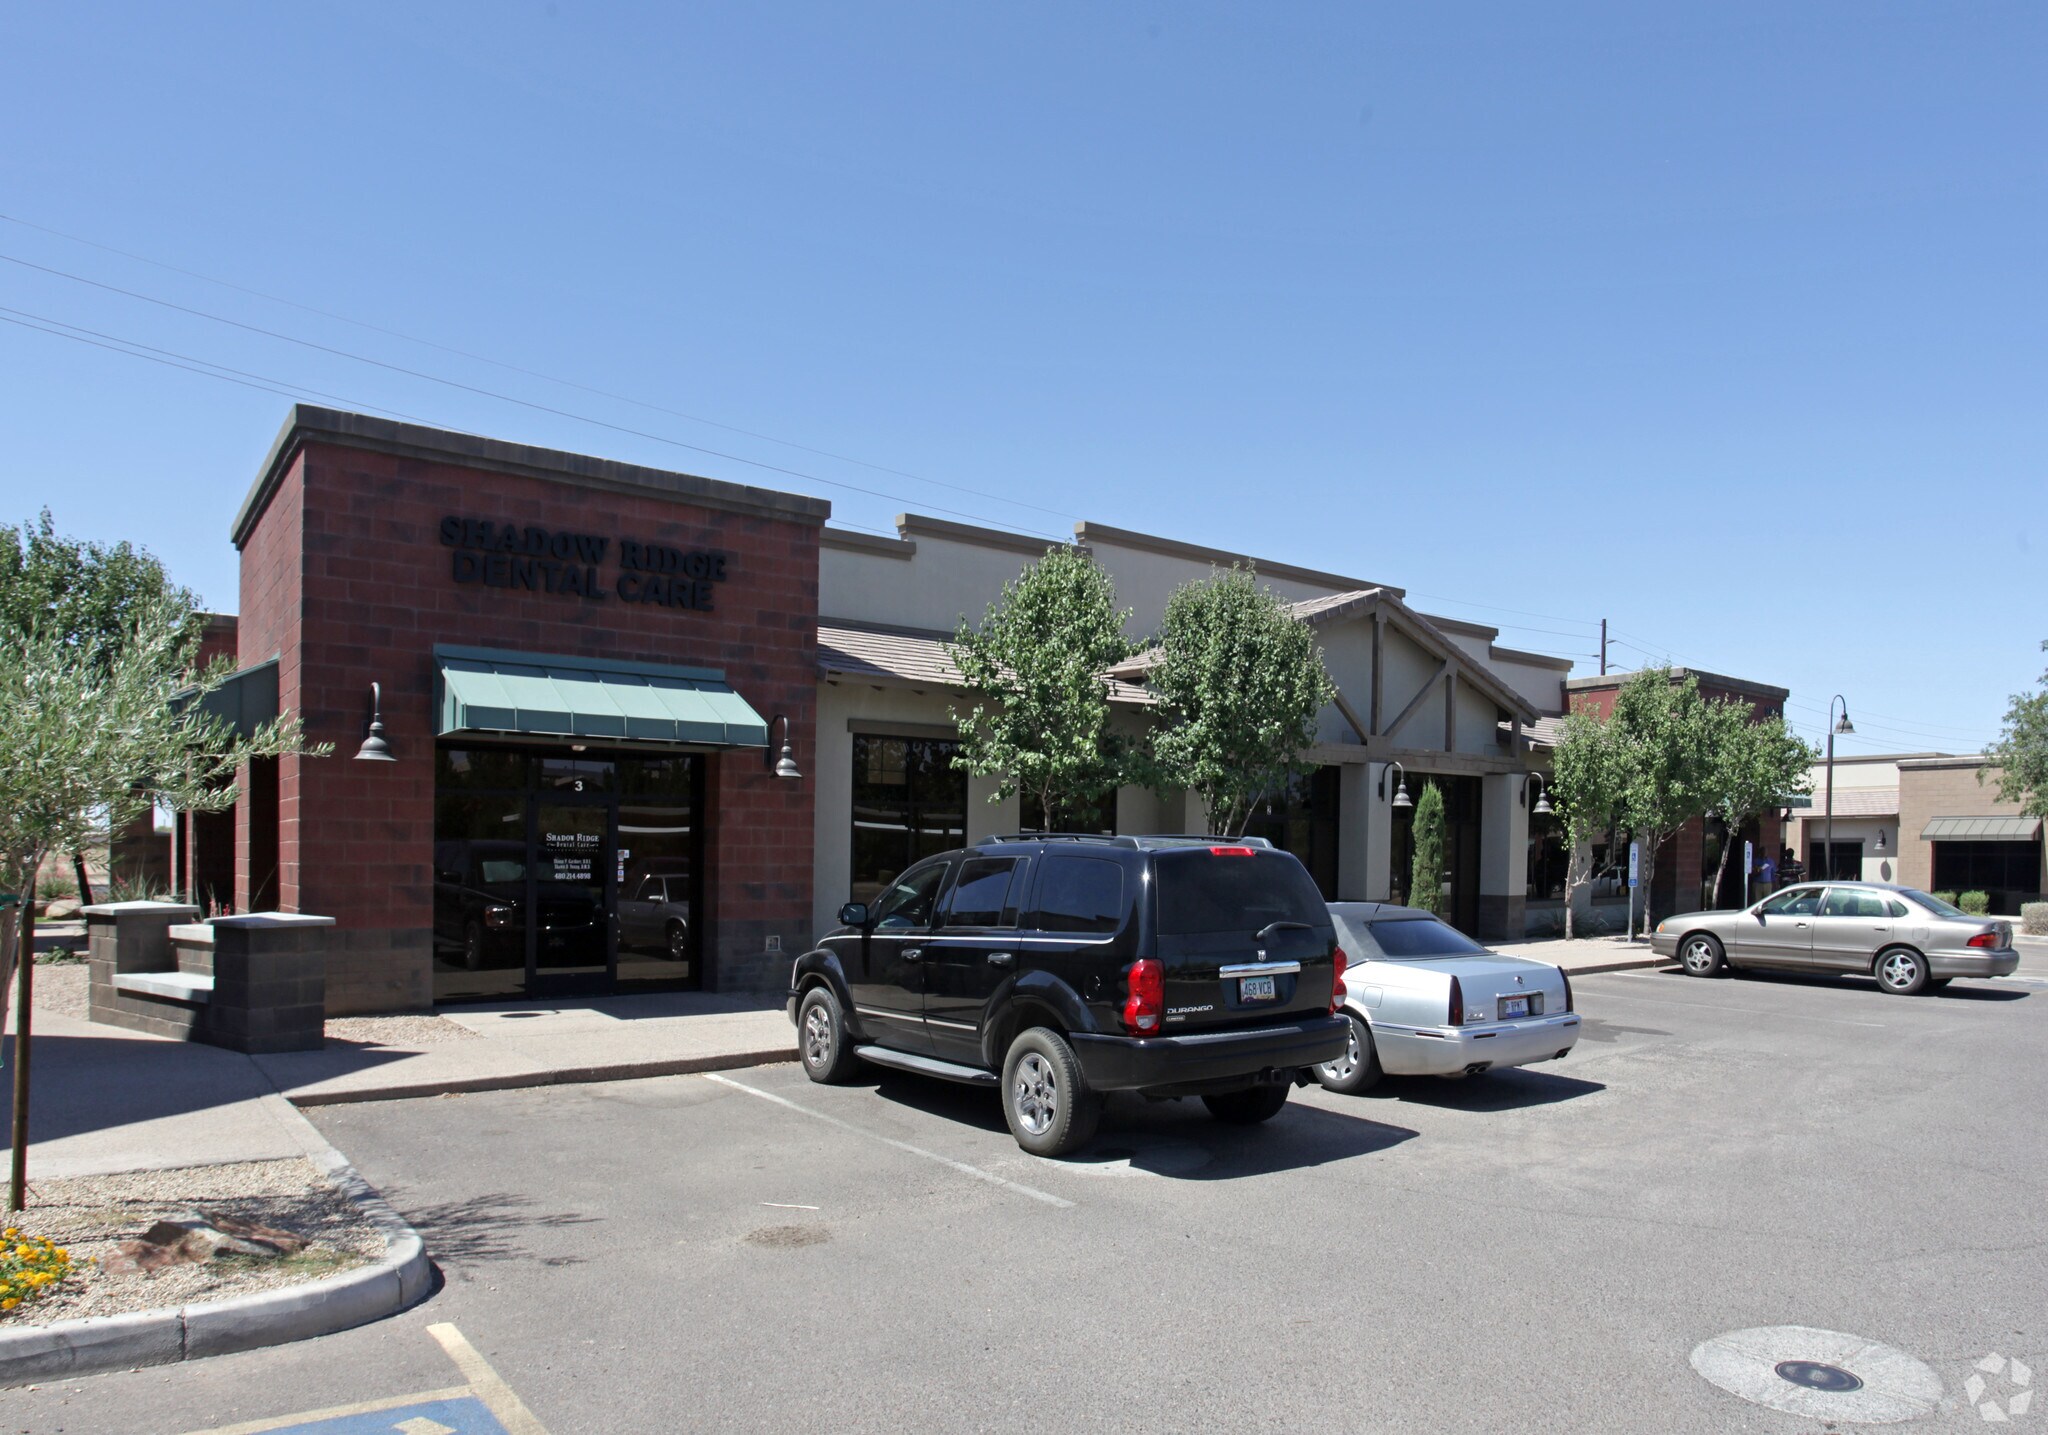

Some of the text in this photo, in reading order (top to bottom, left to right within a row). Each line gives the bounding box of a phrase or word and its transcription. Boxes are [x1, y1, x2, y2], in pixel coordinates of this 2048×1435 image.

[440, 515, 728, 582] SHADOW RIDGE
[453, 551, 715, 612] DENTAL CARE
[574, 780, 584, 792] 3
[1167, 1004, 1213, 1014] DURANGO
